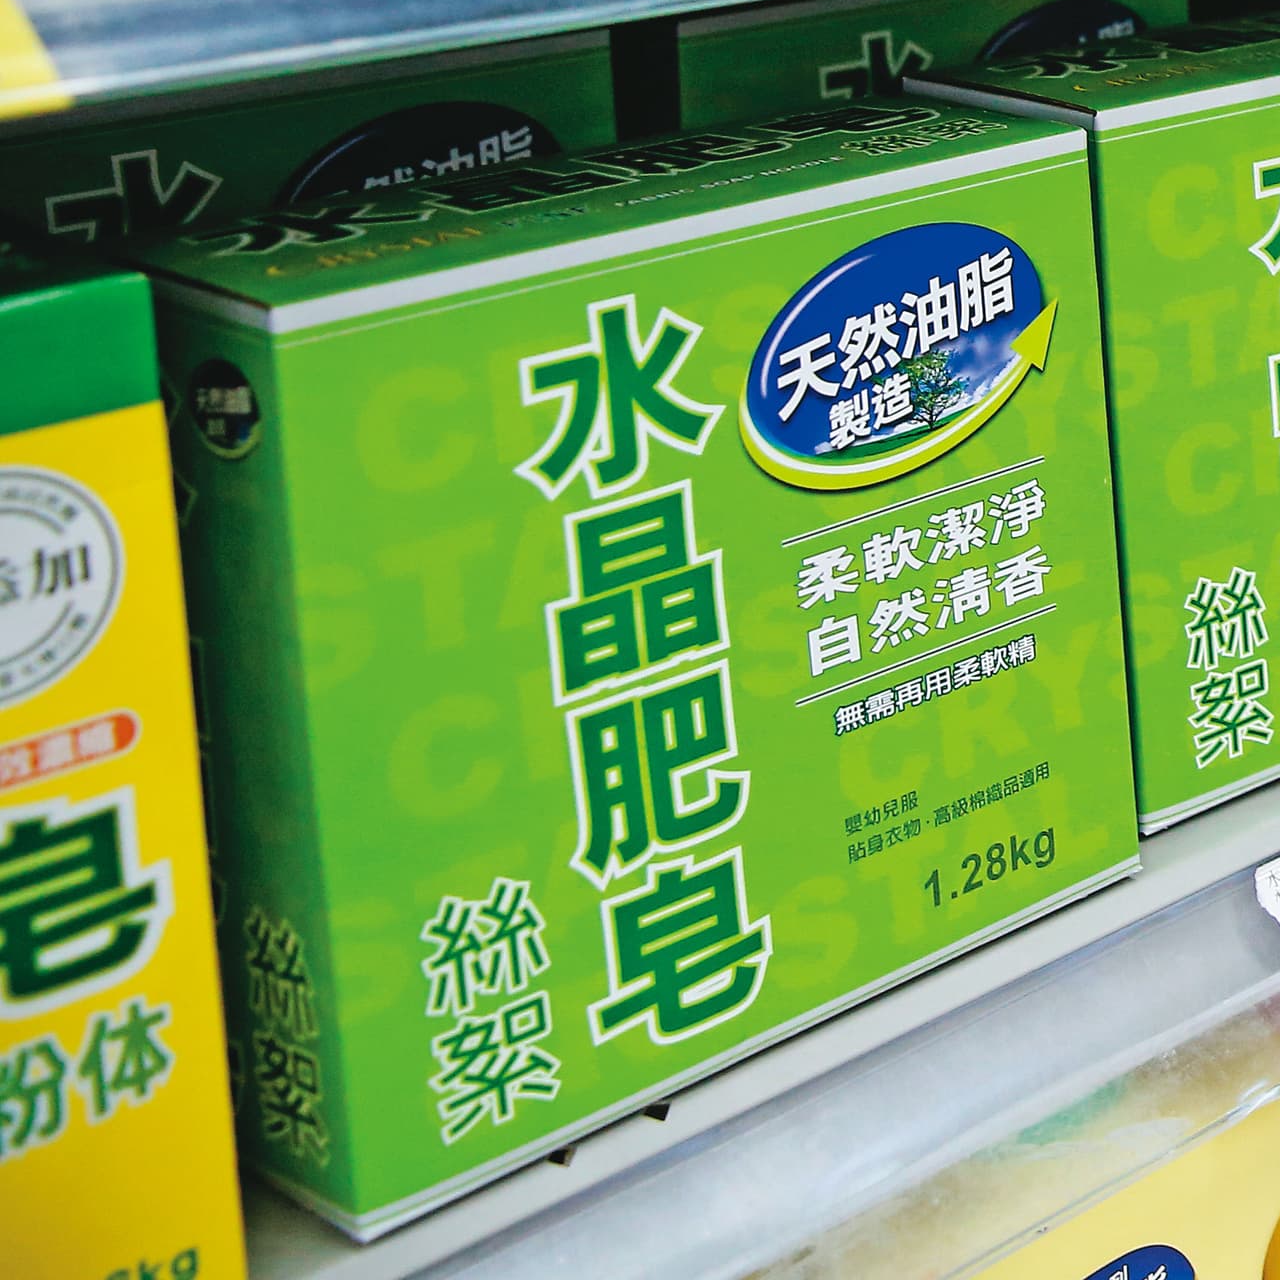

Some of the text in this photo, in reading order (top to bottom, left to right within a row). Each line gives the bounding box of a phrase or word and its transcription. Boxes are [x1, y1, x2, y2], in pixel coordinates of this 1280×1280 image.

[778, 246, 1015, 422] 天然油脂
[828, 371, 915, 451] 製造
[797, 479, 1048, 609] 柔軟潔淨
[513, 294, 772, 1046] 水晶肥皂
[807, 545, 1053, 678] 自然清香
[1183, 566, 1274, 769] 絲絮
[834, 634, 1037, 736] 無需再用柔軟精
[844, 790, 919, 837] 嬰幼兒服
[924, 827, 1056, 908] 1.28kg
[420, 877, 560, 1146] 絲絮
